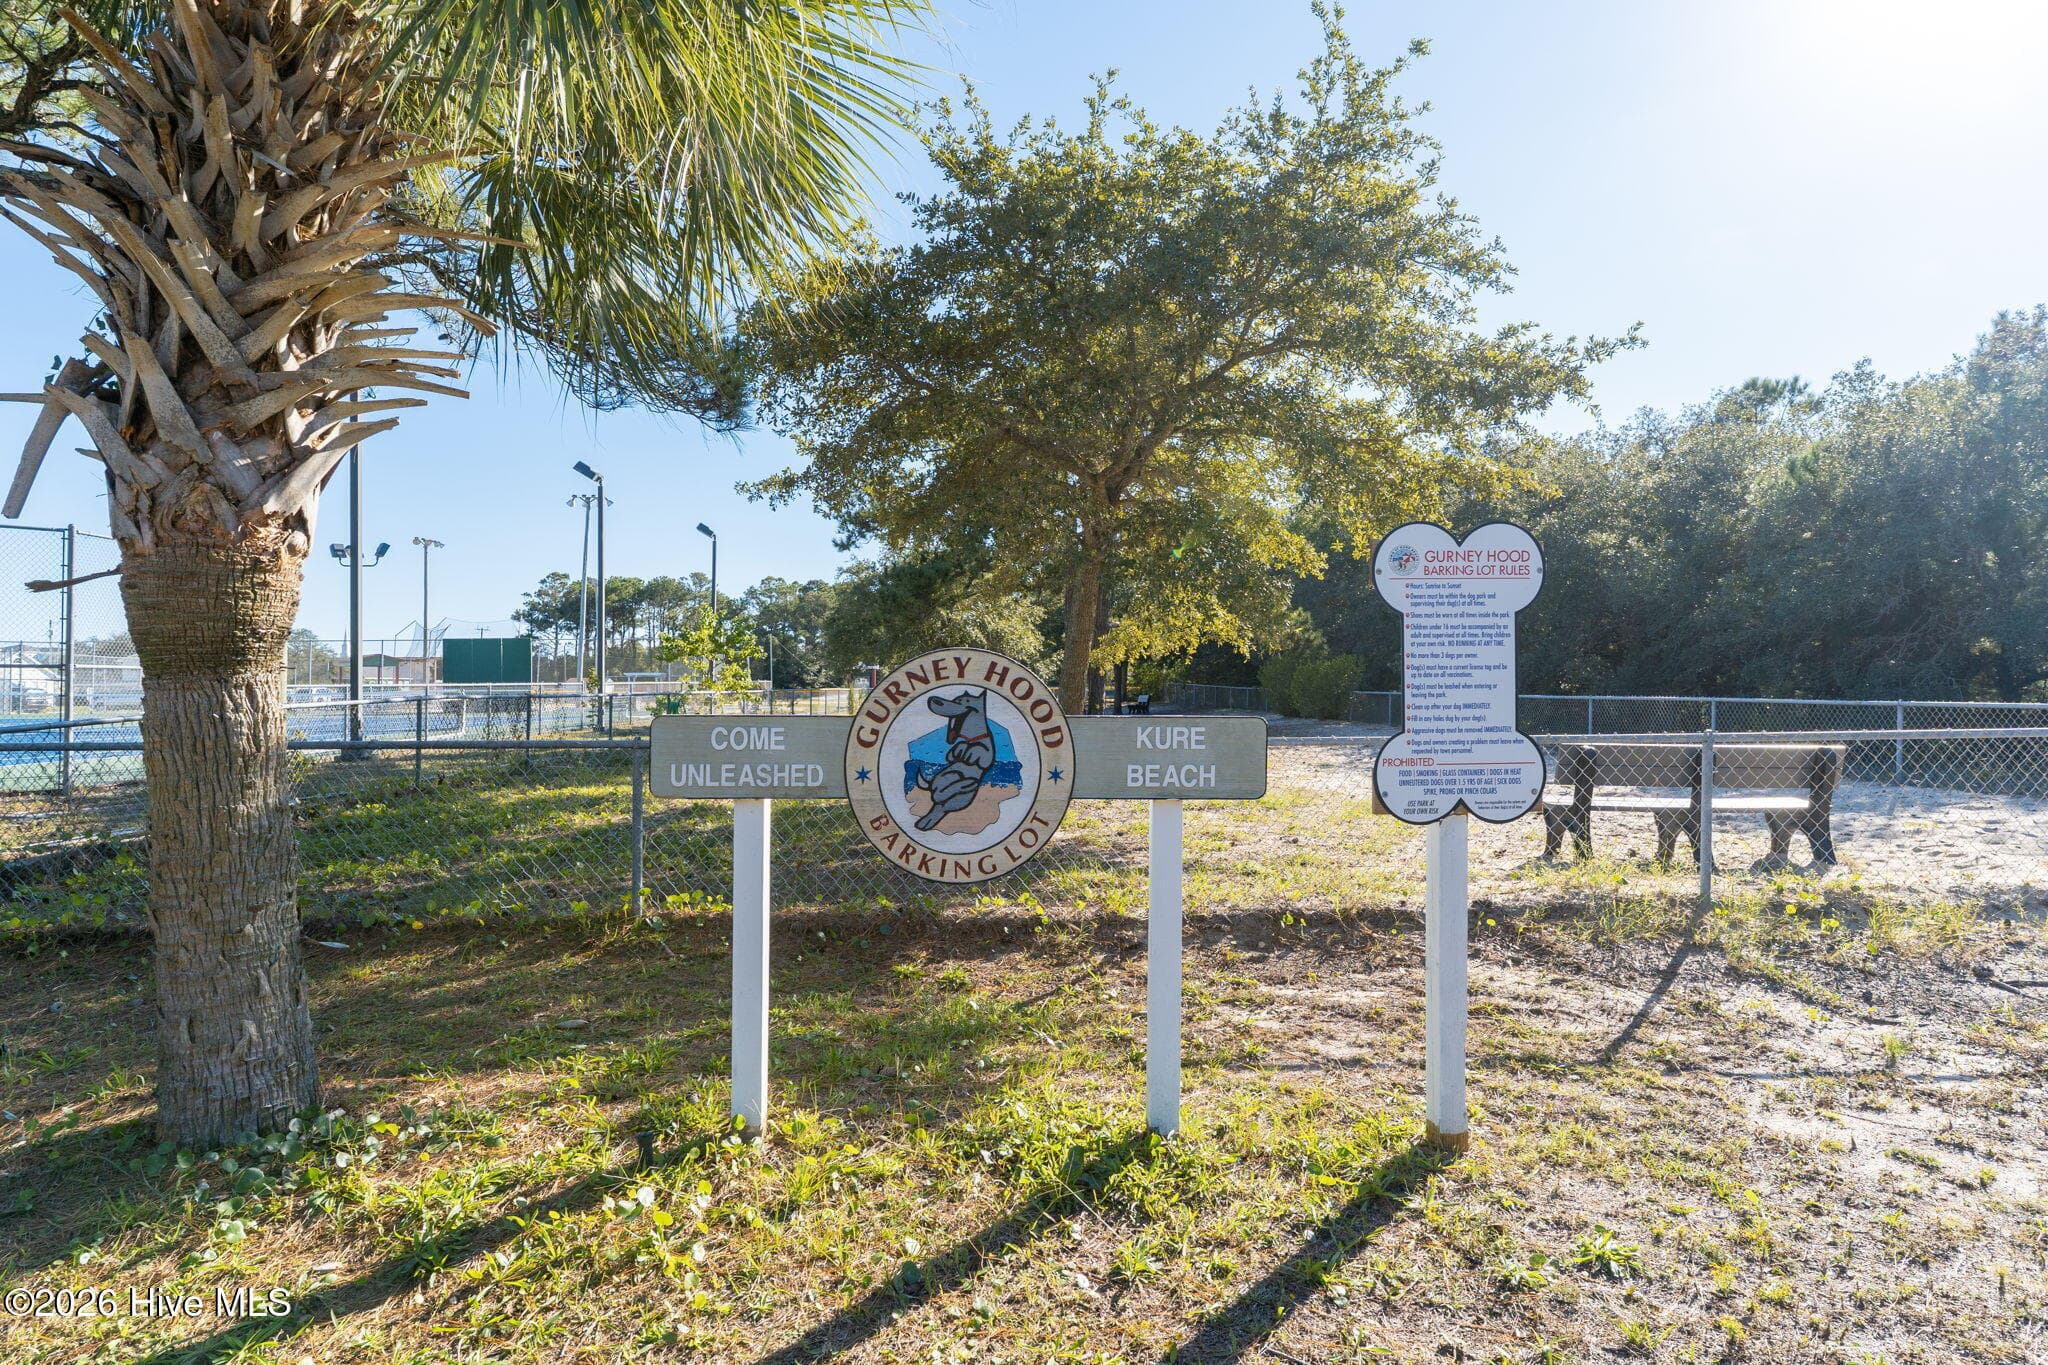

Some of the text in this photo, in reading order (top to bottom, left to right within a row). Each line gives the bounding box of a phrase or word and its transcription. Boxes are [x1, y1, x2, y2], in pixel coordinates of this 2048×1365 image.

[1424, 550, 1530, 562] GURNEY HOOD
[1424, 565, 1530, 575] BARKING LOT RULES
[856, 656, 1064, 749] GURNEY HOOD
[710, 726, 786, 752] COME
[1136, 726, 1206, 750] KURE
[1383, 758, 1434, 766] PROHIBITED
[670, 764, 824, 788] UNLEASHED
[1126, 764, 1216, 788] BEACH
[868, 811, 1052, 879] BARKING LOT
